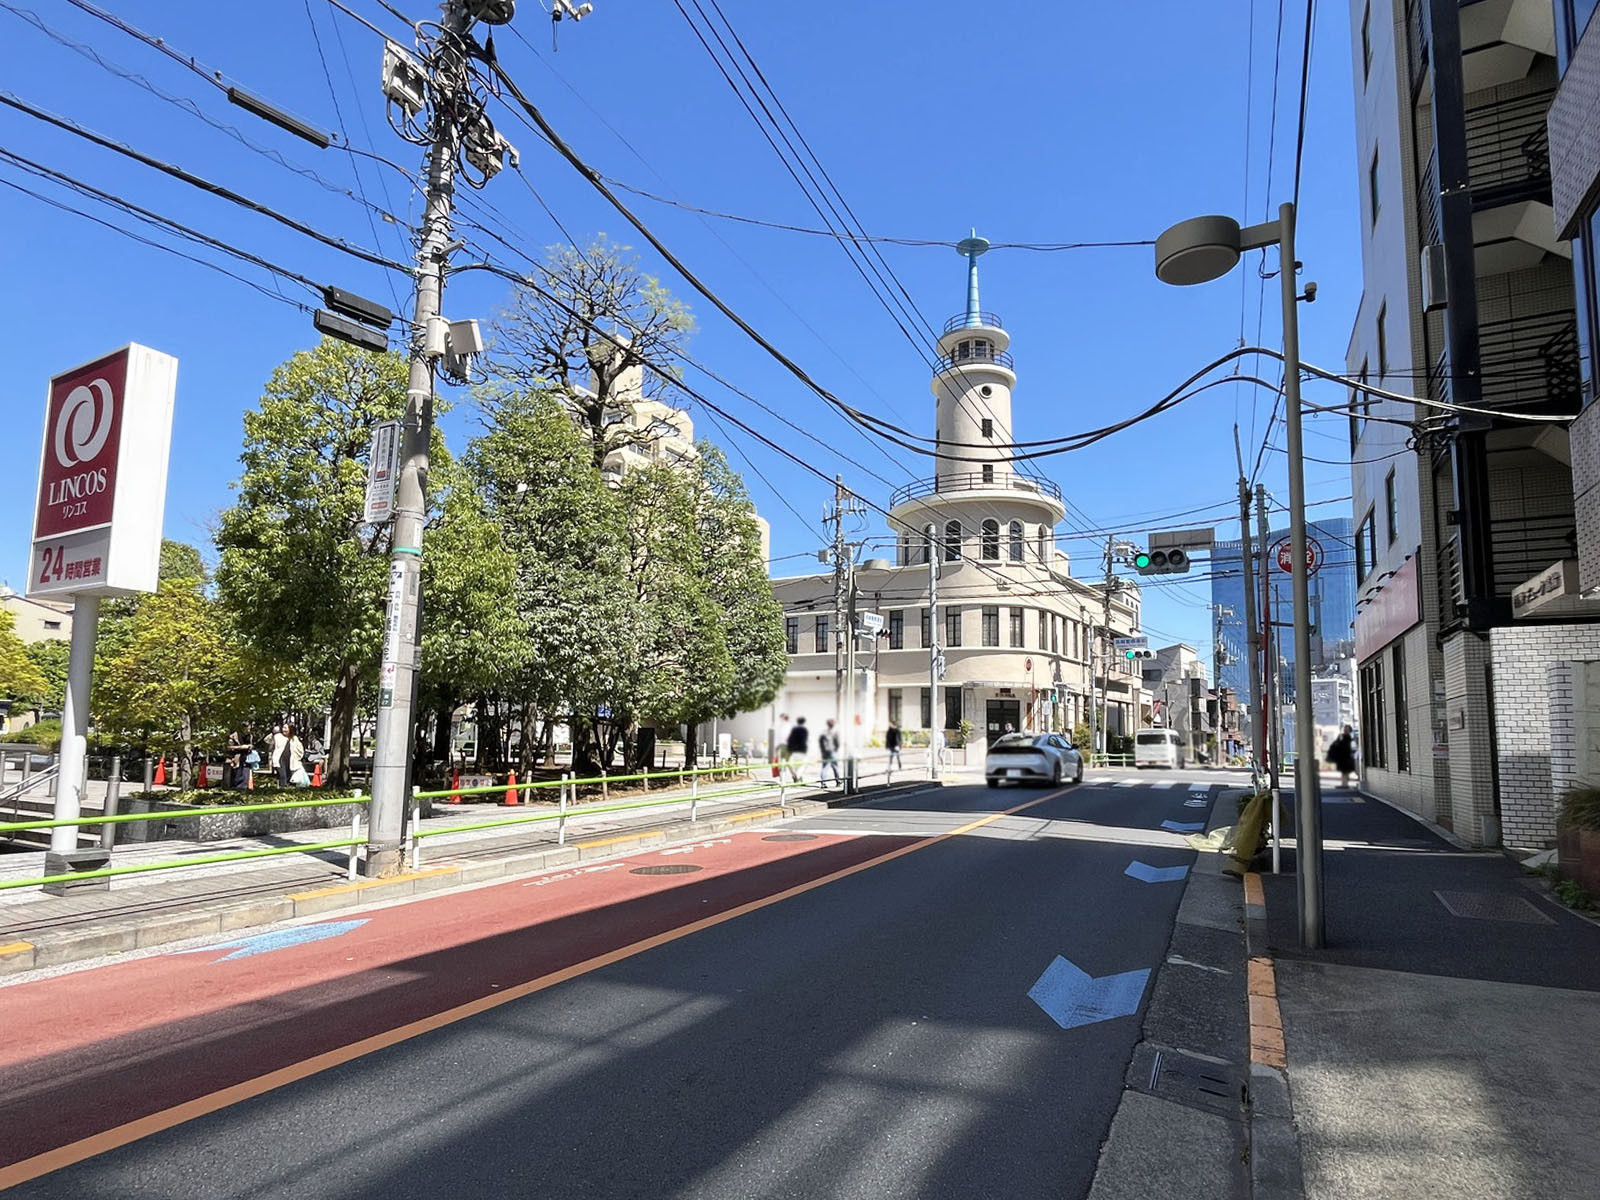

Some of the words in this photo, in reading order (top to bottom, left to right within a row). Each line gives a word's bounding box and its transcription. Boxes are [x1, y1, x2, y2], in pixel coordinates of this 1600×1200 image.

[48, 468, 107, 505] LINCOS
[62, 501, 87, 519] リンコス
